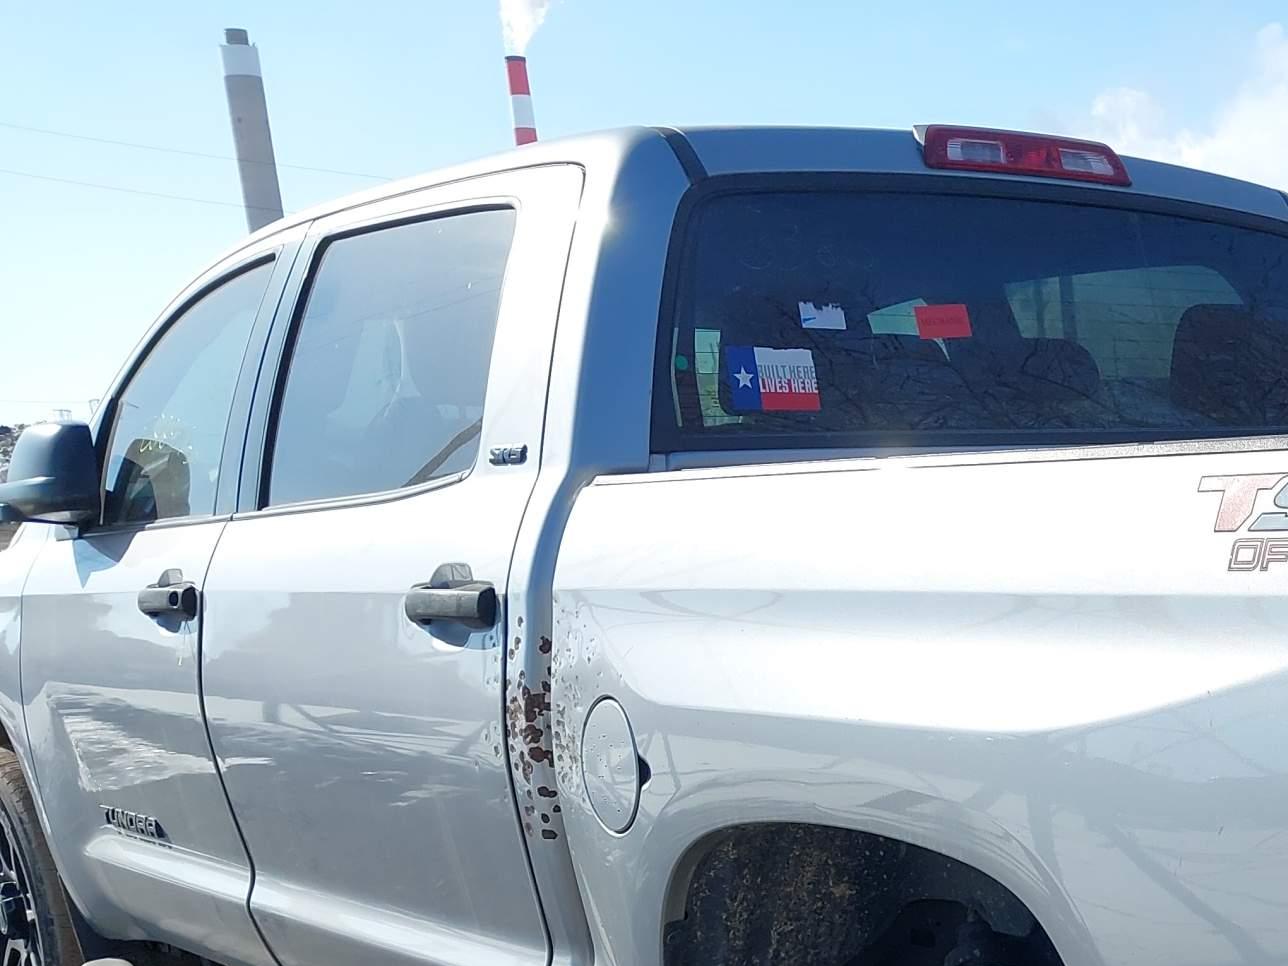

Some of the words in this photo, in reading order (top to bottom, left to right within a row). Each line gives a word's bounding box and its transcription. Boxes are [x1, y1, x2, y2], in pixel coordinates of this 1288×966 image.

[758, 364, 788, 378] BUILT
[789, 365, 816, 379] HERE
[759, 378, 790, 393] LIVES
[791, 379, 819, 393] HERE
[98, 804, 168, 842] TUNDRA
